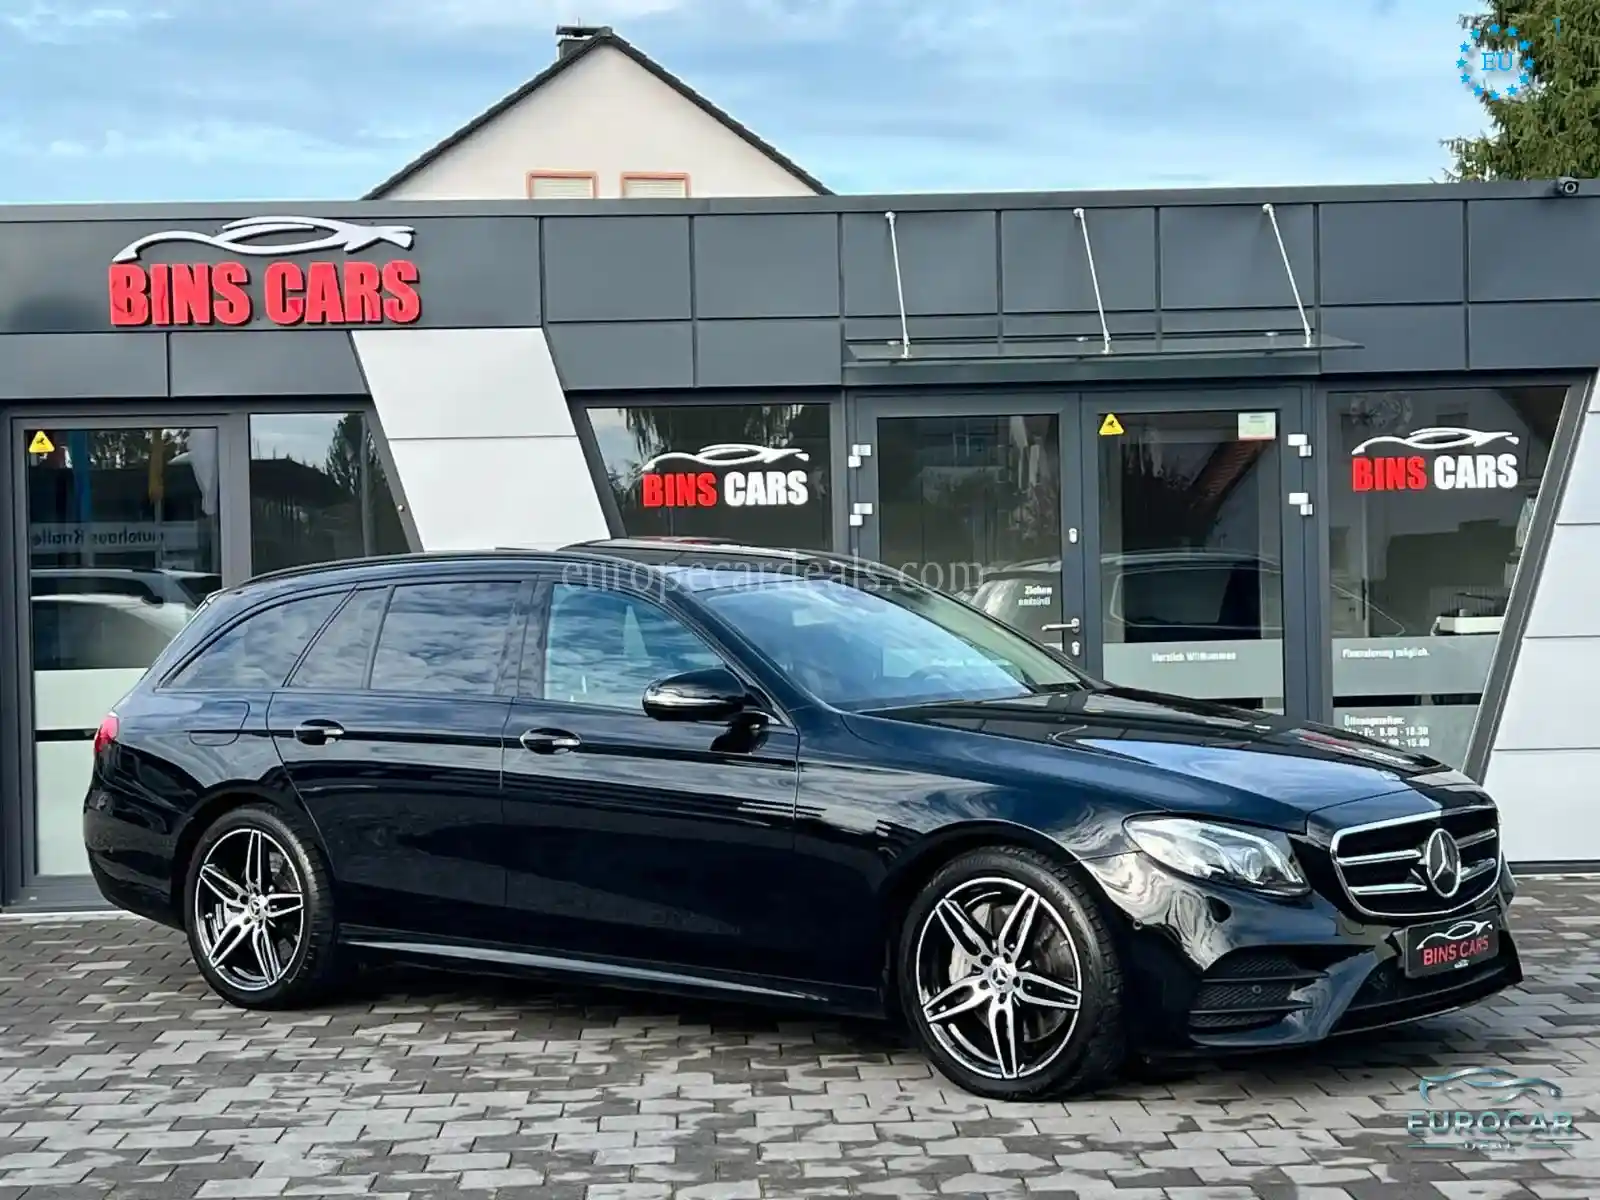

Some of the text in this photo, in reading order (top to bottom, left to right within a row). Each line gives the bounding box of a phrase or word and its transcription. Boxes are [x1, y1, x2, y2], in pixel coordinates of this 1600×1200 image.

[108, 260, 420, 325] BINS CARS
[643, 470, 809, 507] BINS CARS
[1352, 453, 1518, 491] BINS CARS
[1423, 944, 1457, 966] BINS
[1459, 935, 1489, 958] CARS
